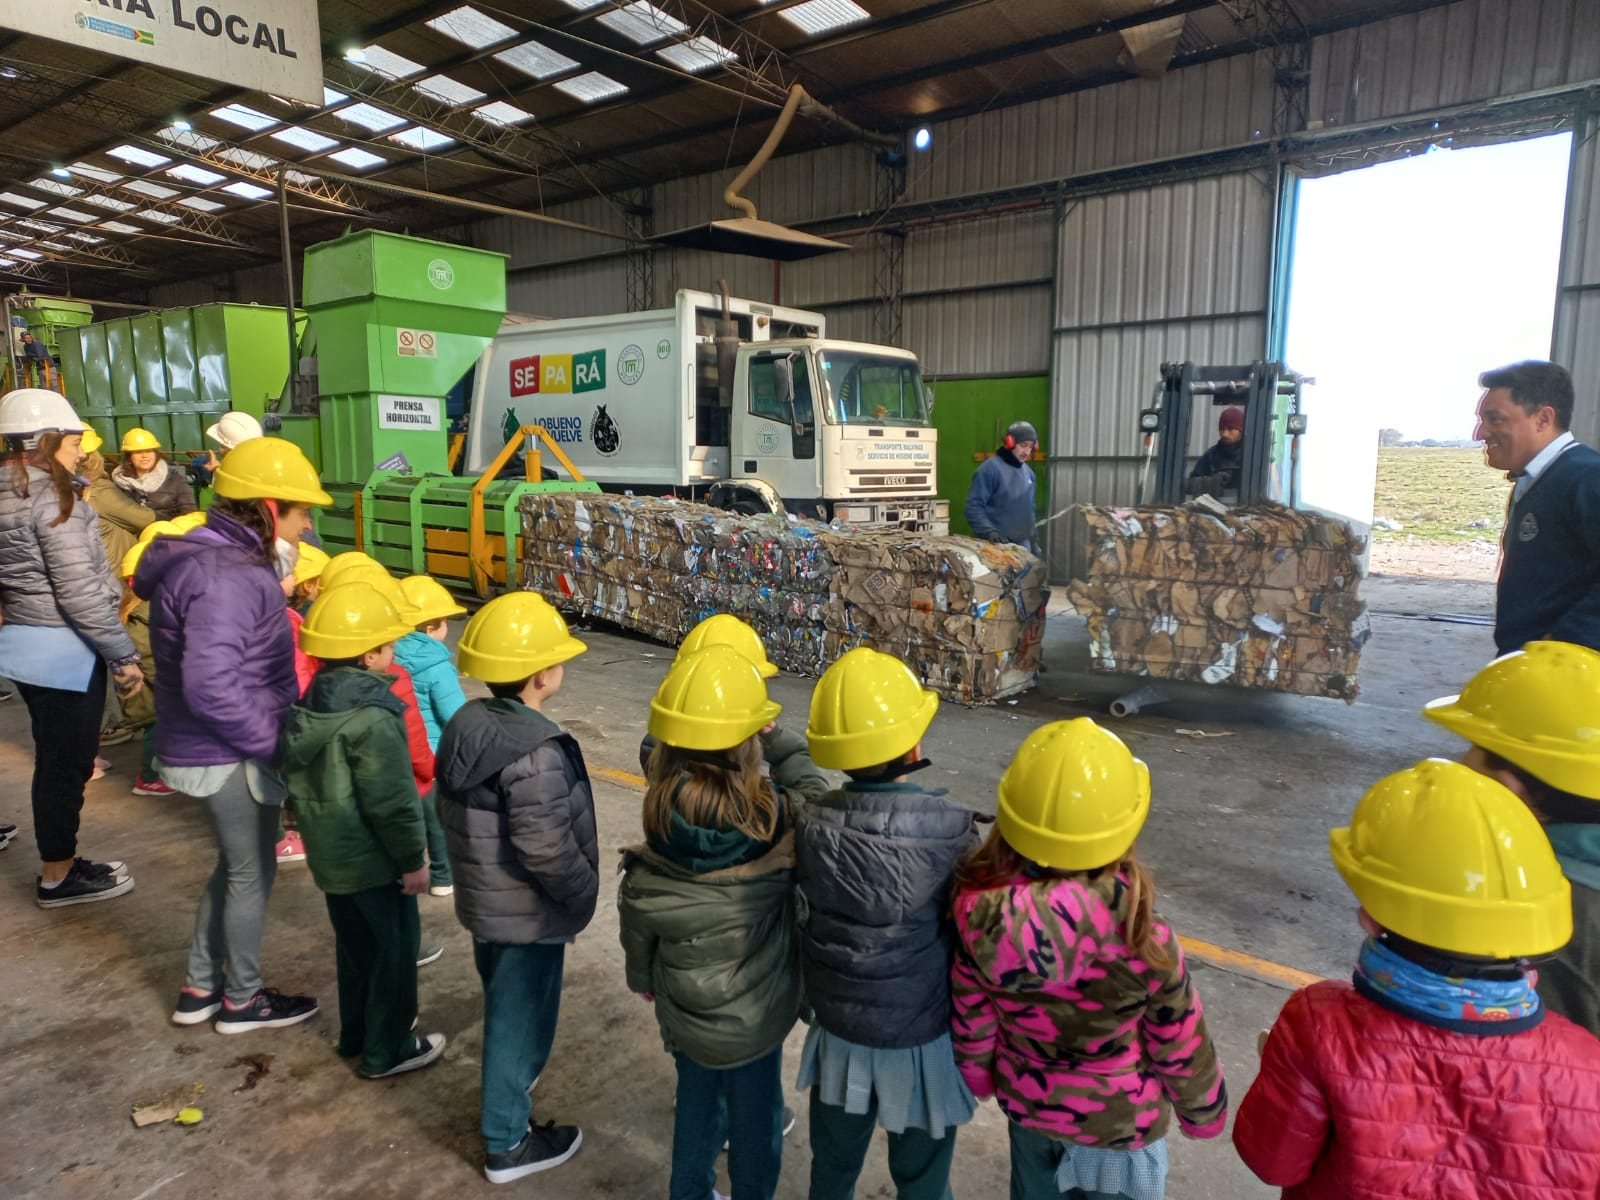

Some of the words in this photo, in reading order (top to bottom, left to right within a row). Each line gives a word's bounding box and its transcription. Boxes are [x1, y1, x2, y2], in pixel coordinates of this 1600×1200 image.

[172, 0, 298, 59] LOCAL
[545, 365, 567, 385] PA
[575, 356, 601, 385] RÁ
[393, 400, 424, 411] PRENSA
[386, 412, 433, 425] HORIZONTAL
[884, 476, 907, 485] IVECO
